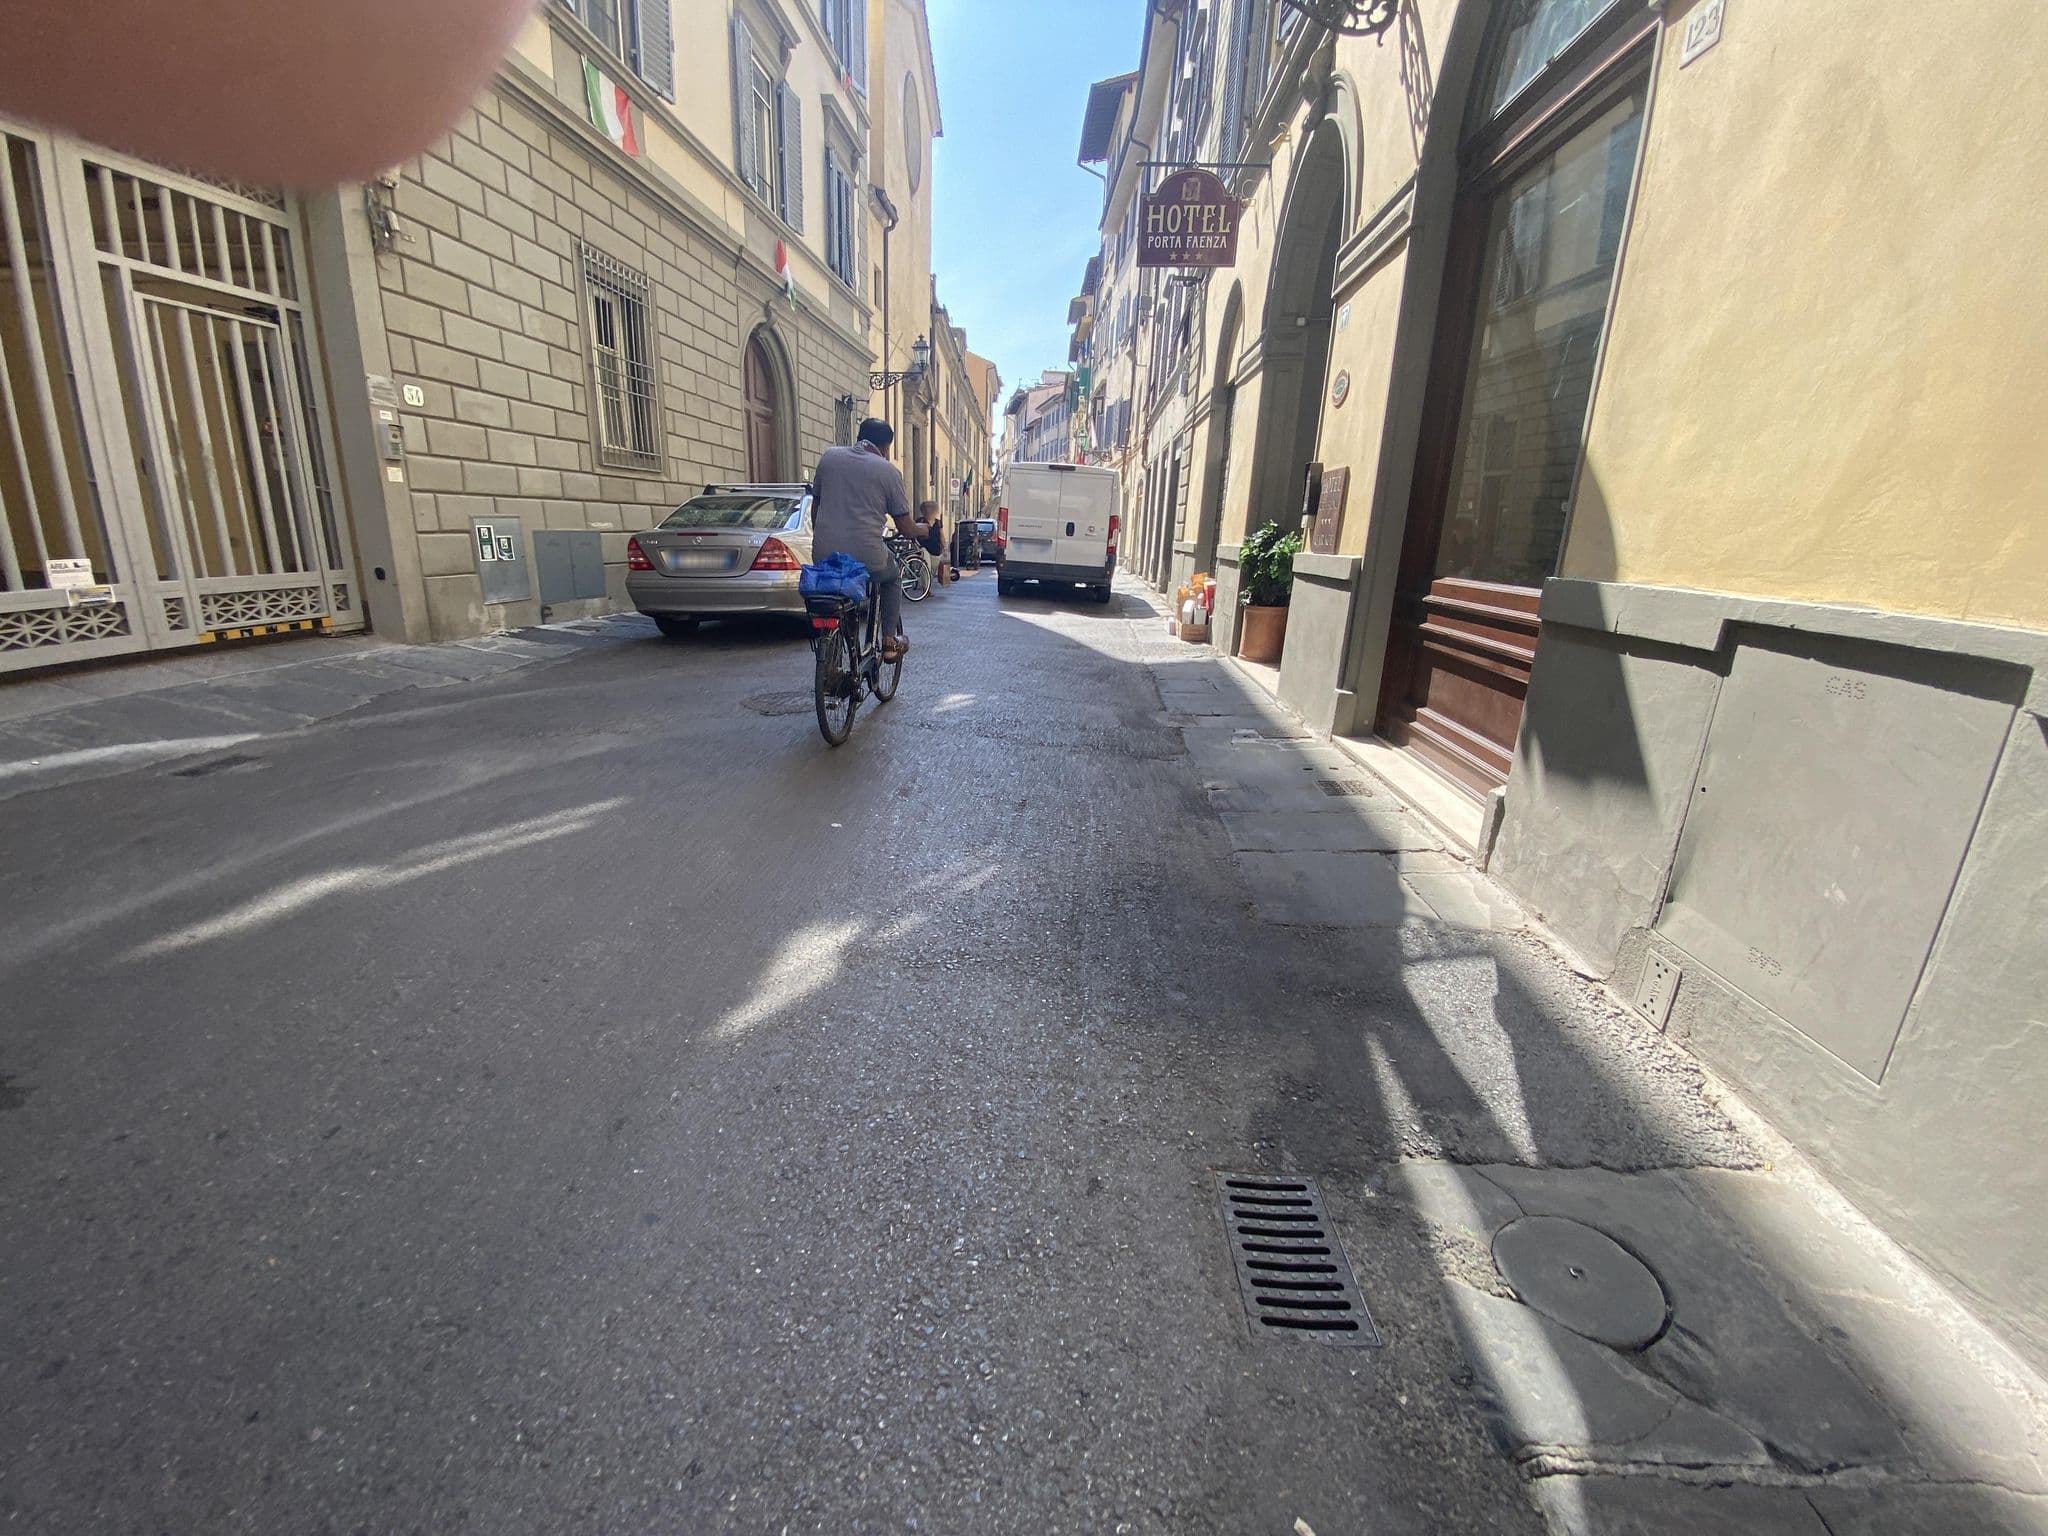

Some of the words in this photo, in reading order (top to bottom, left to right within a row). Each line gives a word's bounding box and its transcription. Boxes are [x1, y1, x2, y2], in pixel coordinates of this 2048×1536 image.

[1686, 6, 1719, 53] 123
[1147, 204, 1232, 233] HOTEL
[1147, 235, 1182, 249] PORTA
[1186, 235, 1227, 249] FAENZA
[1825, 675, 1867, 700] GAS
